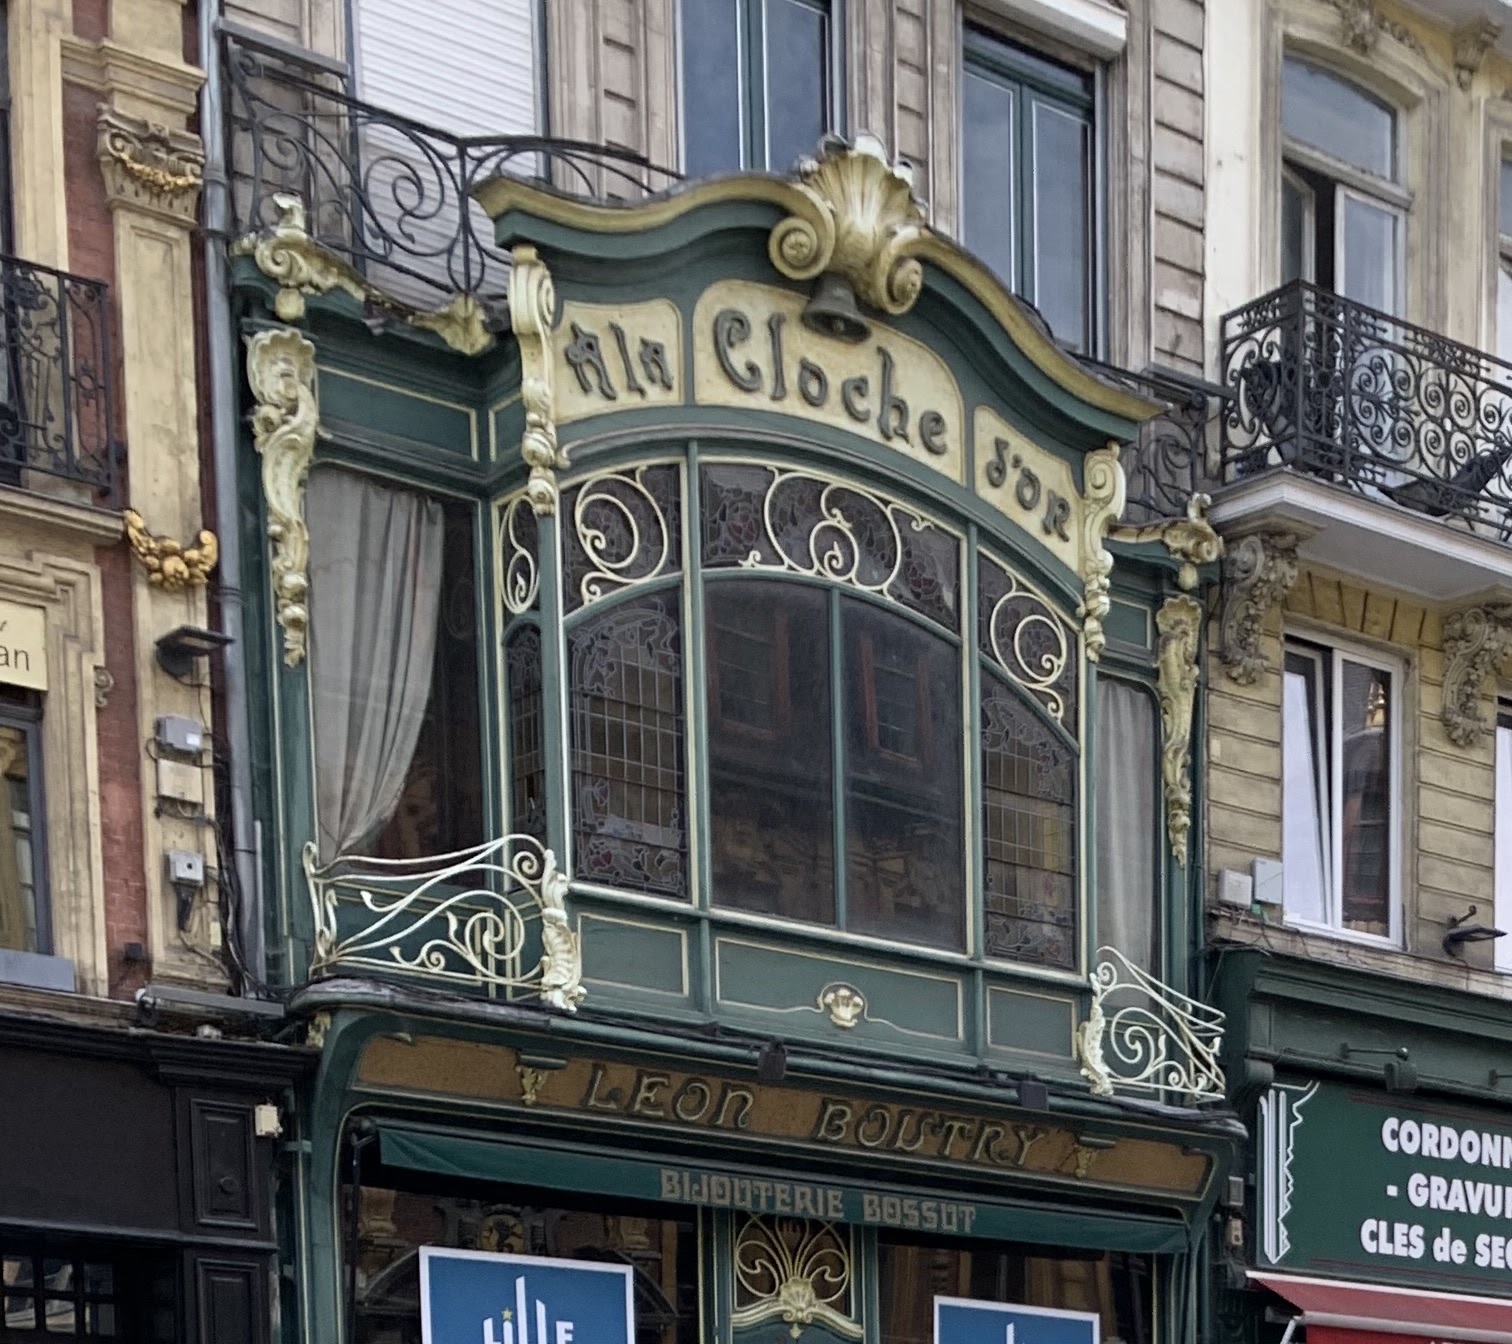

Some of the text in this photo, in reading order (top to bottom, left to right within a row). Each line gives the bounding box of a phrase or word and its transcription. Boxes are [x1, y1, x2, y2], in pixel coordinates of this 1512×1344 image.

[713, 309, 947, 455] Cloche
[581, 1063, 1044, 1166] LEON BOUTRY
[660, 1168, 977, 1234] BIJOUTERIE BOSSUT
[1360, 1219, 1425, 1260] CLES
[1433, 1229, 1467, 1265] de
